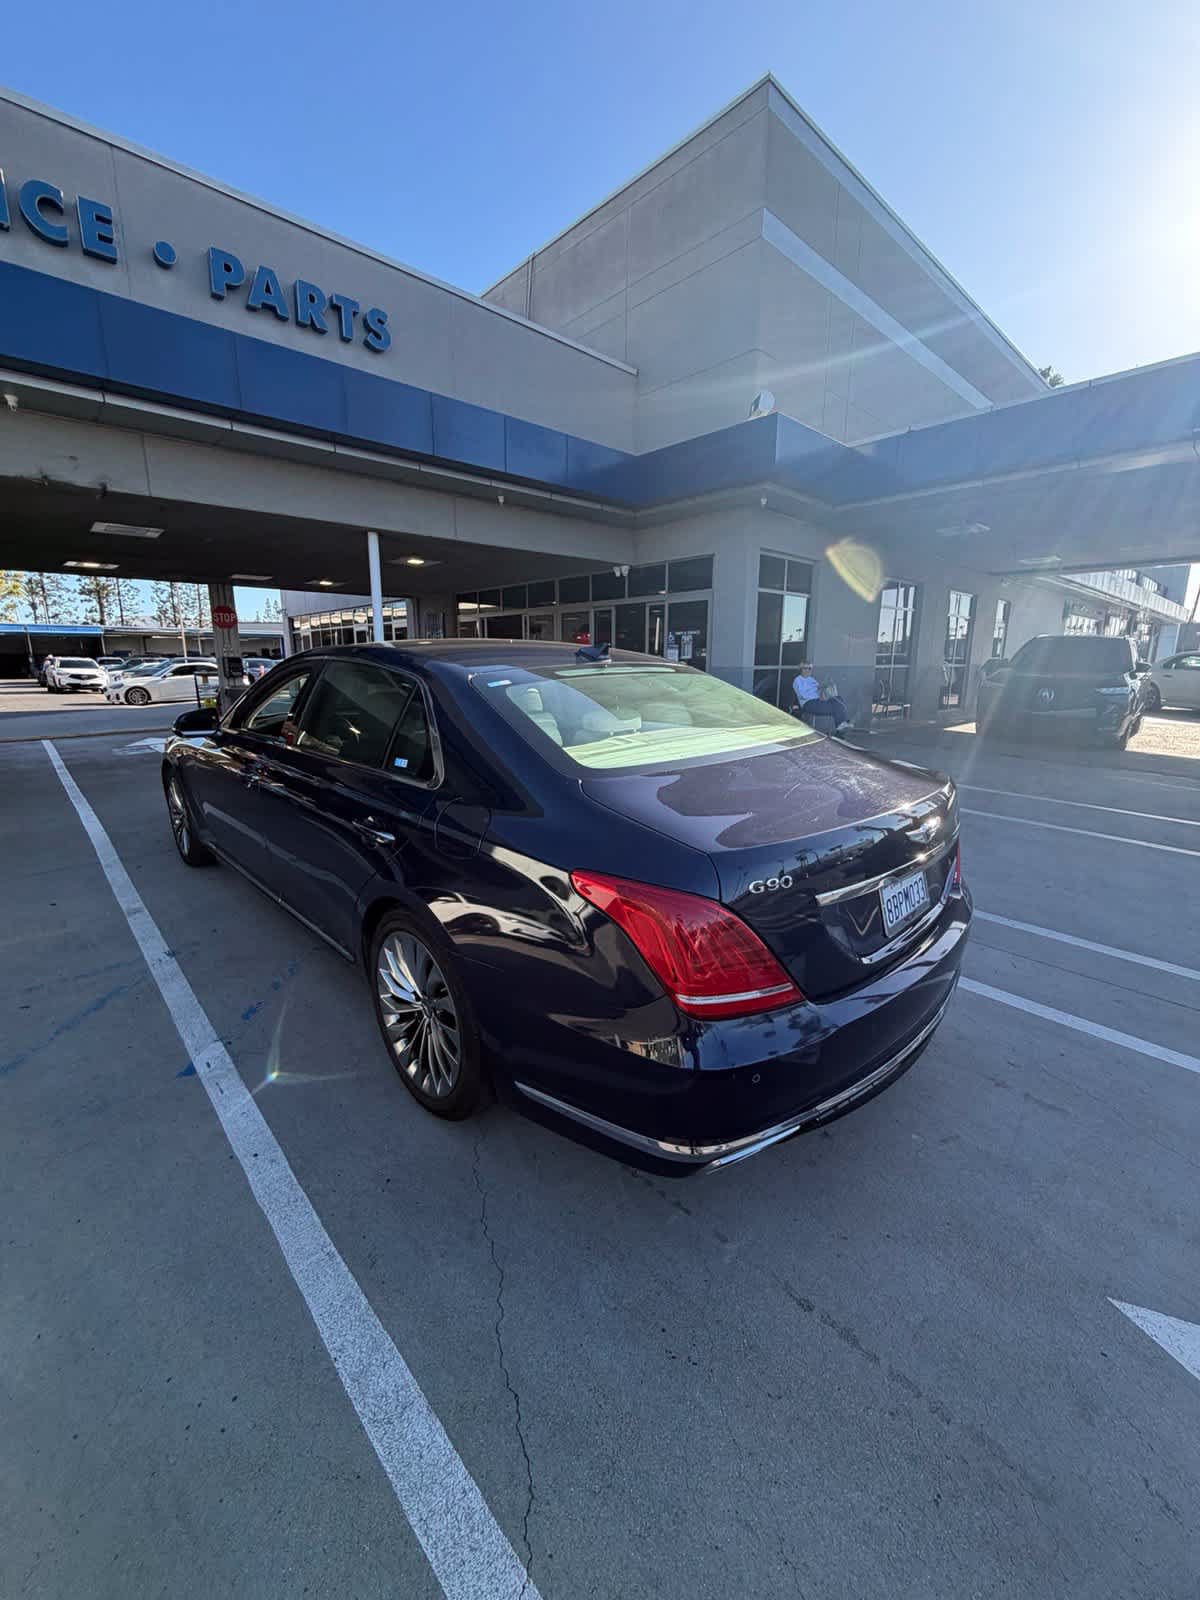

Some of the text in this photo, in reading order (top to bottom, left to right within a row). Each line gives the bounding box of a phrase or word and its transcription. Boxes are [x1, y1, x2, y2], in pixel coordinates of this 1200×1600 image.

[207, 246, 392, 353] PARTS
[213, 612, 236, 623] STOP
[749, 875, 793, 894] G90
[886, 877, 926, 924] 8BPM033
